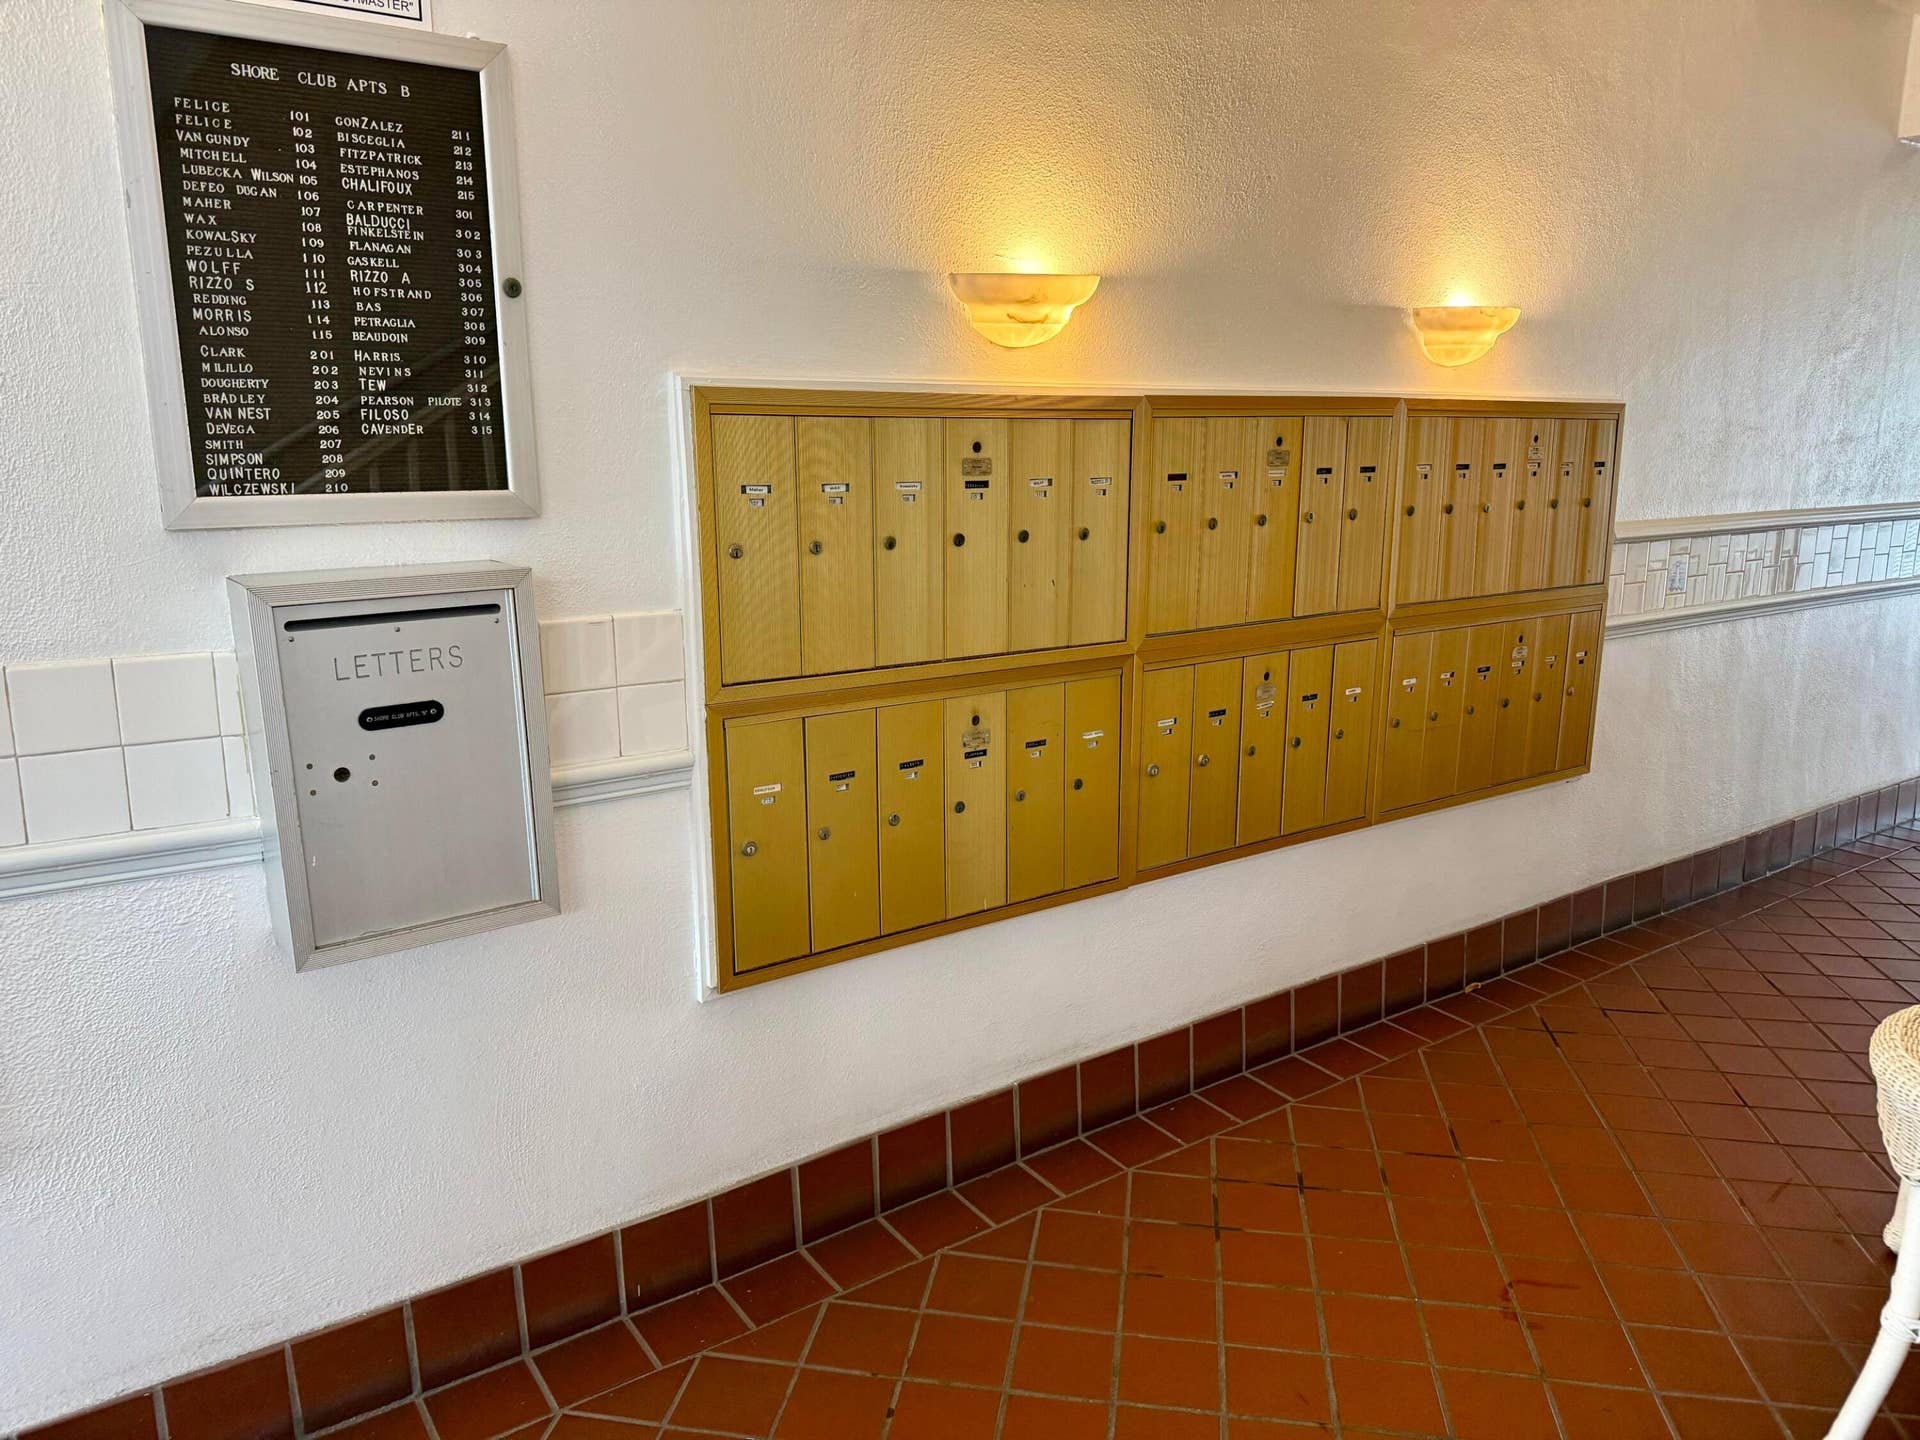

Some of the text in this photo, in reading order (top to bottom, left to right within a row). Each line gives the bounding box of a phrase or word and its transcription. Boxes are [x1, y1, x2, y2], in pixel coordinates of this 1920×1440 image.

[230, 62, 411, 98] SHORE CLUB APTS B
[289, 110, 310, 123] 101
[292, 125, 313, 139] 102
[334, 116, 471, 142] GONZALEZ 211
[175, 128, 316, 155] VAN GUNDY 103
[179, 147, 318, 171] MITCHELL 104
[339, 147, 473, 172] FITZPATRICK 213
[453, 145, 472, 157] 212
[181, 163, 318, 186] LUBECKA WILSON 105
[339, 162, 474, 186] ESTEPHANOS 214
[182, 179, 320, 202] DEFEO DUGAN 106
[341, 176, 476, 201] CHALIFOUX 215
[182, 195, 321, 217] MAHER 107
[346, 199, 473, 220] CARPENTER 301
[183, 212, 322, 233] WAX 108
[345, 213, 411, 231] BALDUCCI
[185, 228, 325, 249] KOWALSKY 109
[346, 226, 481, 242] FINKELSTEIN 302
[186, 244, 326, 264] PEZULLA 110
[349, 240, 483, 260] FLANAGAN 303
[185, 258, 325, 280] WOLFF 111
[346, 255, 482, 274] GASKELL 304
[188, 275, 328, 295] RIZZO S 112
[349, 269, 482, 289] RIZZO A 305
[192, 293, 331, 310] REDDING 113
[352, 286, 483, 303] HOFSTRAND 306
[192, 307, 331, 325] MORRIS 114
[355, 301, 485, 318] BAS 307
[198, 325, 333, 340] ALONSO 115
[353, 316, 486, 332] PETRAGLIA 308
[351, 331, 486, 346] BEAUDOIN 309
[199, 344, 335, 361] CLARK 201
[353, 349, 487, 365] HARRIS 310
[201, 362, 339, 376] MILILLO 202
[358, 365, 484, 379] NEVINS 311
[200, 377, 339, 390] DOUGHERTY 203
[357, 377, 488, 393] TEW 312
[202, 391, 340, 405] BRADLEY 204
[360, 395, 492, 407] PEARSON PILOTE 313
[204, 406, 341, 421] VAN NEST 205
[360, 408, 491, 422] FILOSO 314
[318, 424, 340, 435] 206
[360, 422, 493, 436] CAVENDER 315
[204, 438, 342, 450] SMITH 207
[205, 452, 344, 467] SIMPSON 208
[206, 466, 346, 481] QUINTERO 209
[208, 482, 349, 495] WILCZEWSKI 210
[333, 645, 464, 681] LETTERS
